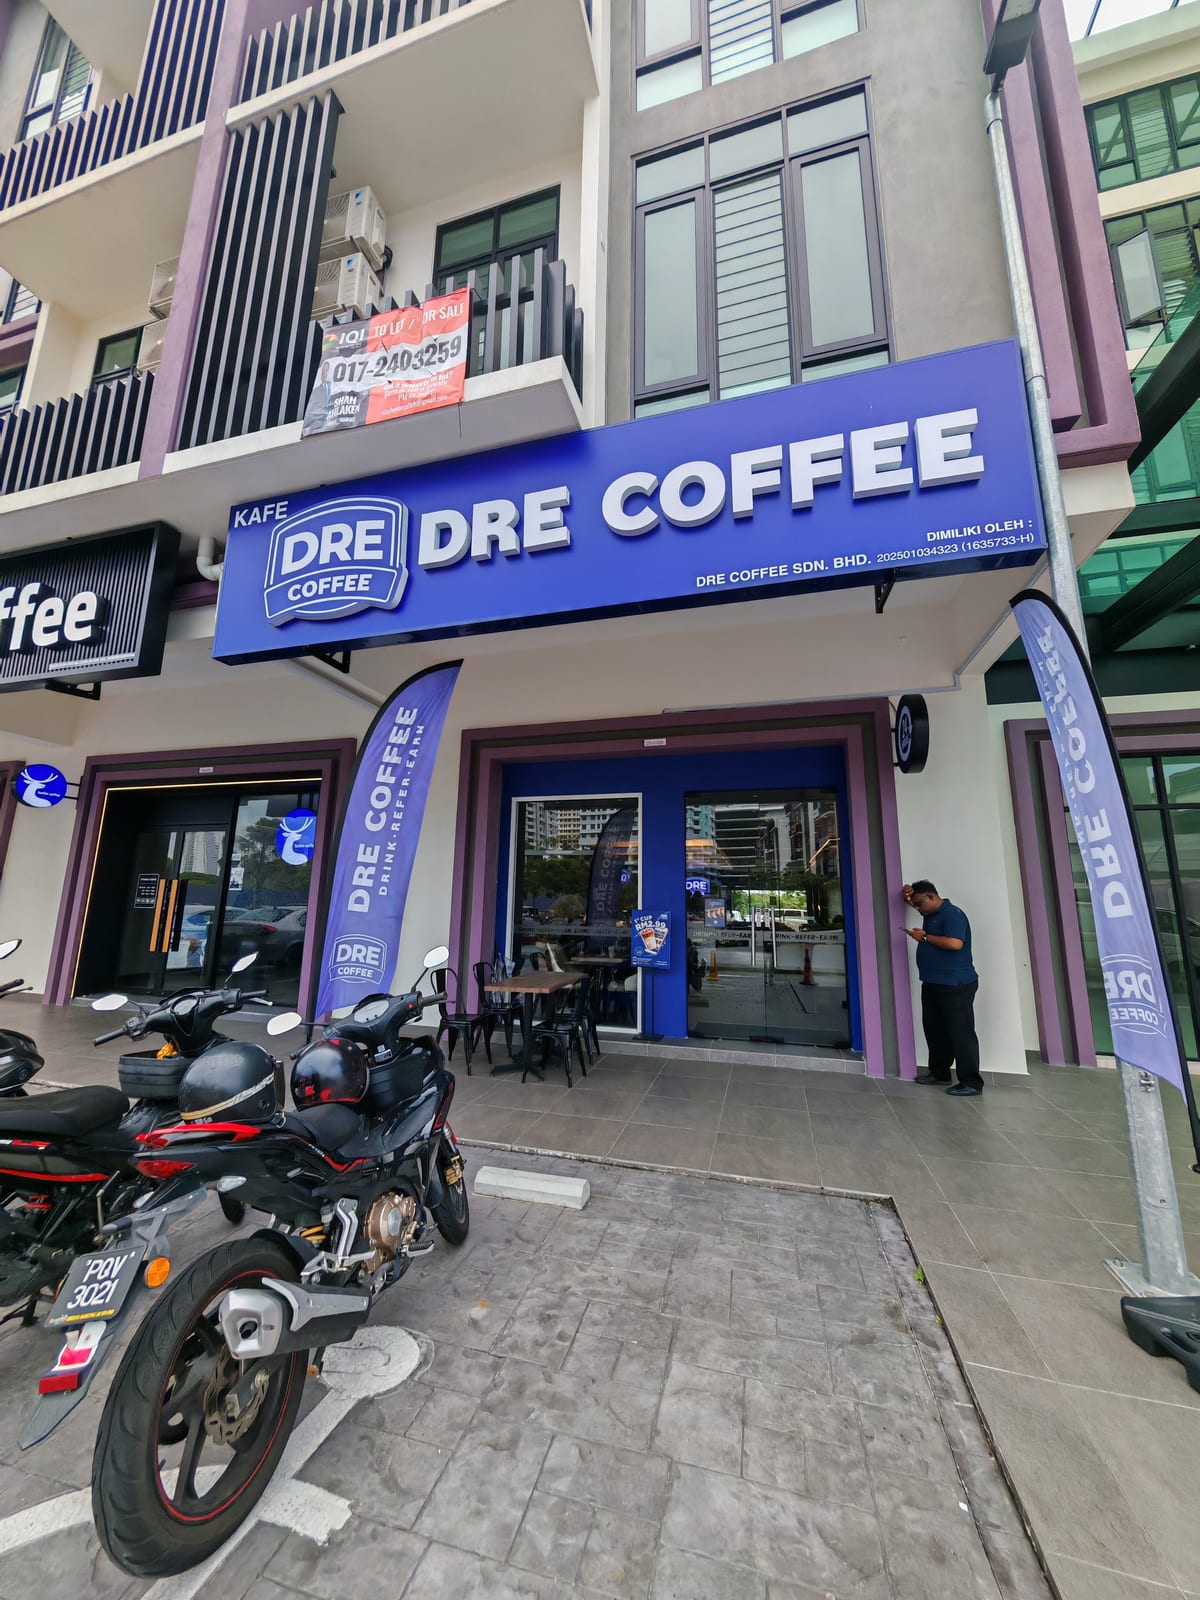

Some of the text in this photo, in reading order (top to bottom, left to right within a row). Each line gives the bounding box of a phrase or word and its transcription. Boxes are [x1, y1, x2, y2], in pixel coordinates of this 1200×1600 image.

[374, 325, 386, 338] TO
[390, 318, 406, 336] LET
[439, 303, 465, 319] SALE
[339, 328, 365, 345] IQI
[333, 335, 462, 383] 017-2403259
[334, 395, 357, 408] SHAH
[417, 408, 984, 571] DRE COFFEE
[233, 501, 289, 528] KAFE
[927, 525, 981, 542] DIMILIKI
[985, 519, 1024, 534] OLEH
[281, 520, 386, 576] DRE
[696, 532, 1035, 588] DRE COFFEE SDN. BHD. 202501034323 (1635733-H)
[287, 574, 373, 601] COFFEE
[347, 706, 419, 914] DRE COFFEE
[336, 944, 381, 966] DRE
[337, 966, 374, 978] COFFEE
[82, 1254, 129, 1284] PQV
[66, 1278, 119, 1310] 3021
